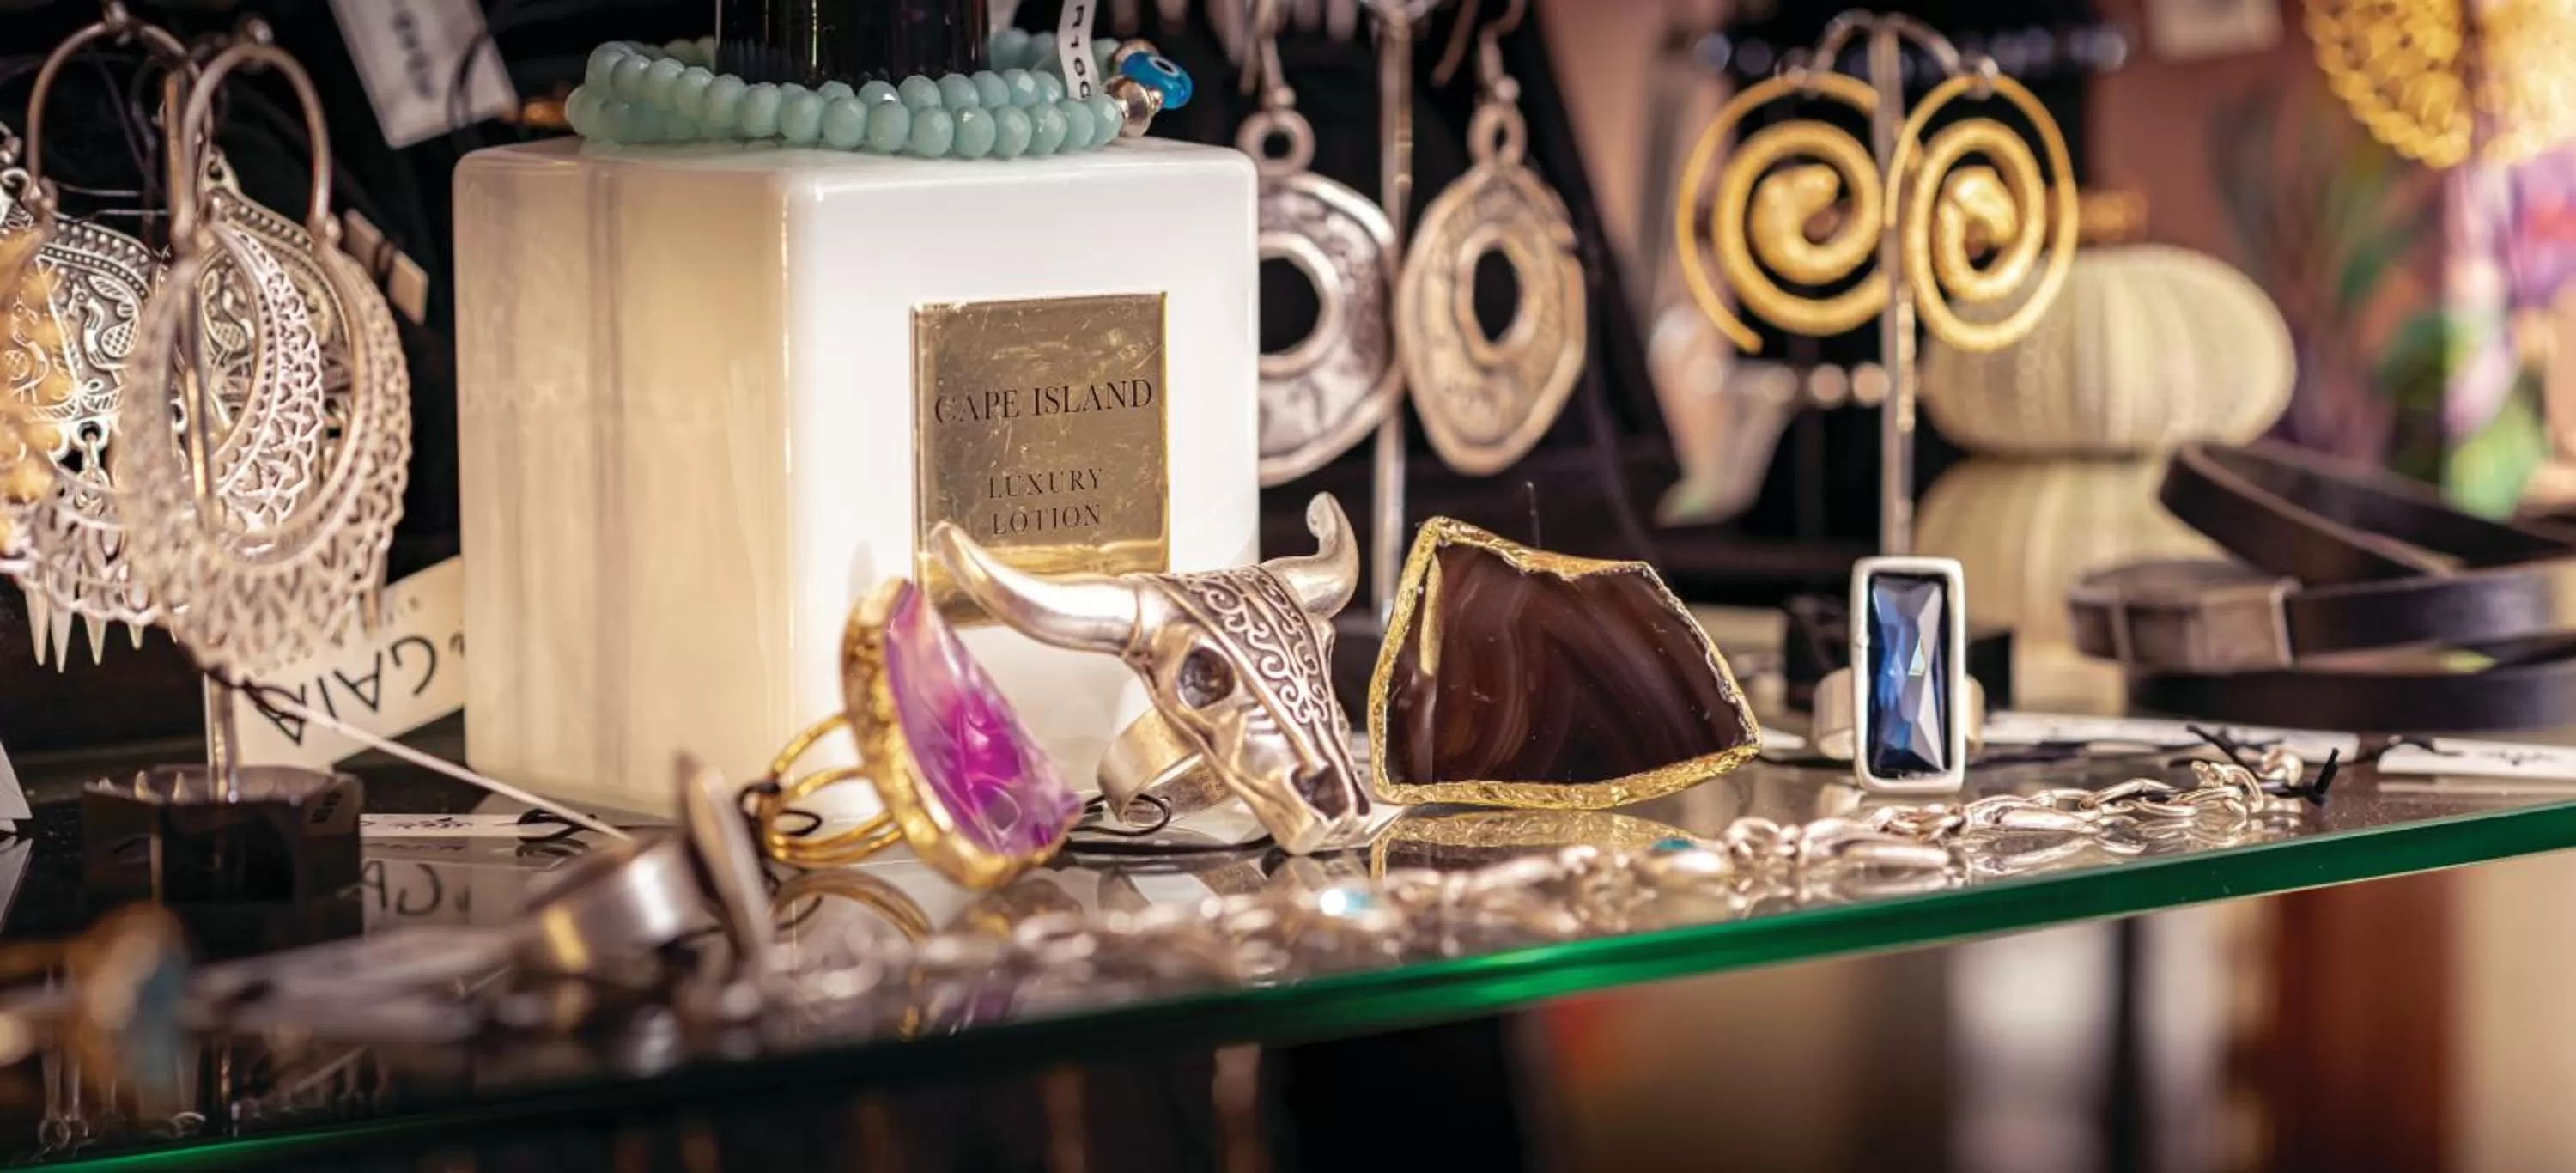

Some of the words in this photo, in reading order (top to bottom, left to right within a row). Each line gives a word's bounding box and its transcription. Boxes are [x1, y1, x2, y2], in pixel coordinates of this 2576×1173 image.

[934, 389, 1020, 423] CAPE
[1033, 378, 1153, 416] ISLAND
[989, 468, 1103, 499] LUXURY
[993, 503, 1101, 536] LOTION
